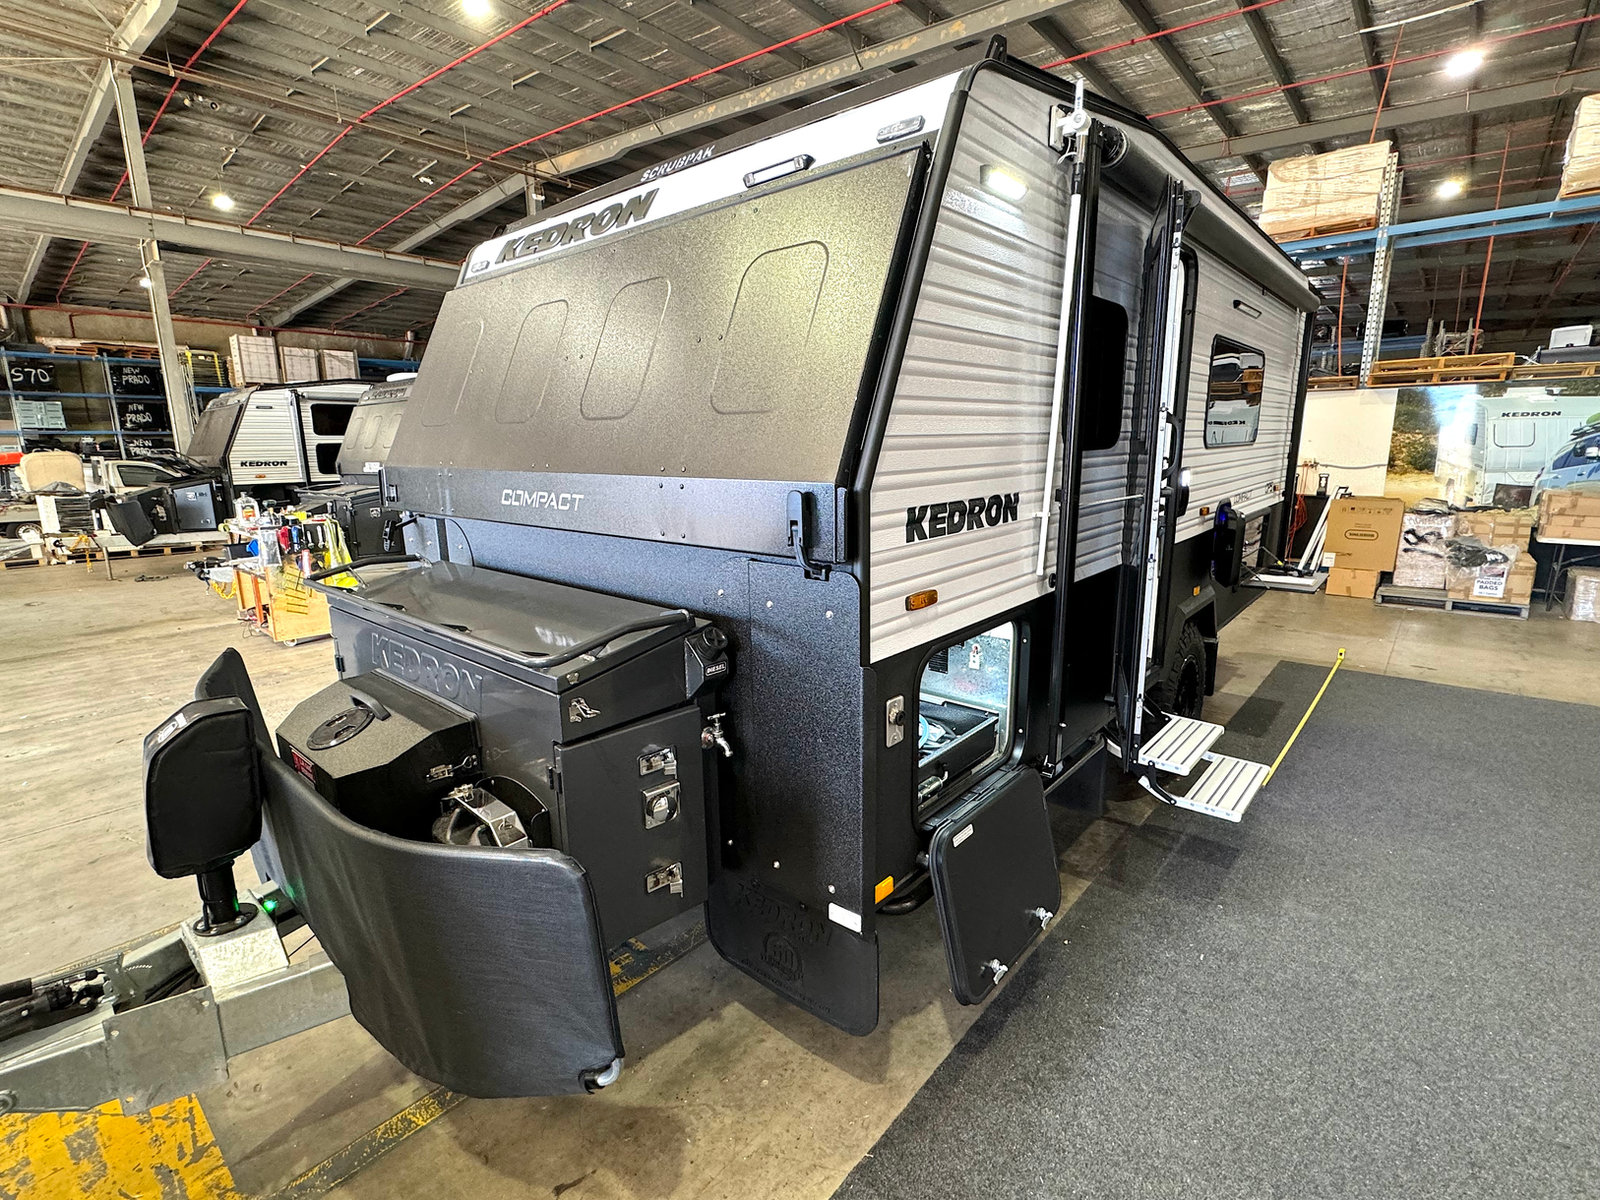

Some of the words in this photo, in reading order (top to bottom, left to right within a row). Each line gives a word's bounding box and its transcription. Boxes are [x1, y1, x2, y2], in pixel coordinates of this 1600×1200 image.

[640, 144, 716, 182] SCRUBPAK
[495, 187, 660, 265] KEDRON
[122, 366, 140, 374] NEW
[122, 374, 151, 385] PRADO
[128, 403, 144, 411] NEW
[126, 412, 153, 424] PRADO
[1501, 410, 1562, 418] KEDRON
[501, 489, 585, 511] COMPACT
[905, 491, 1020, 544] KEDRON
[371, 632, 483, 711] KEDRON
[706, 663, 726, 674] DIESEL
